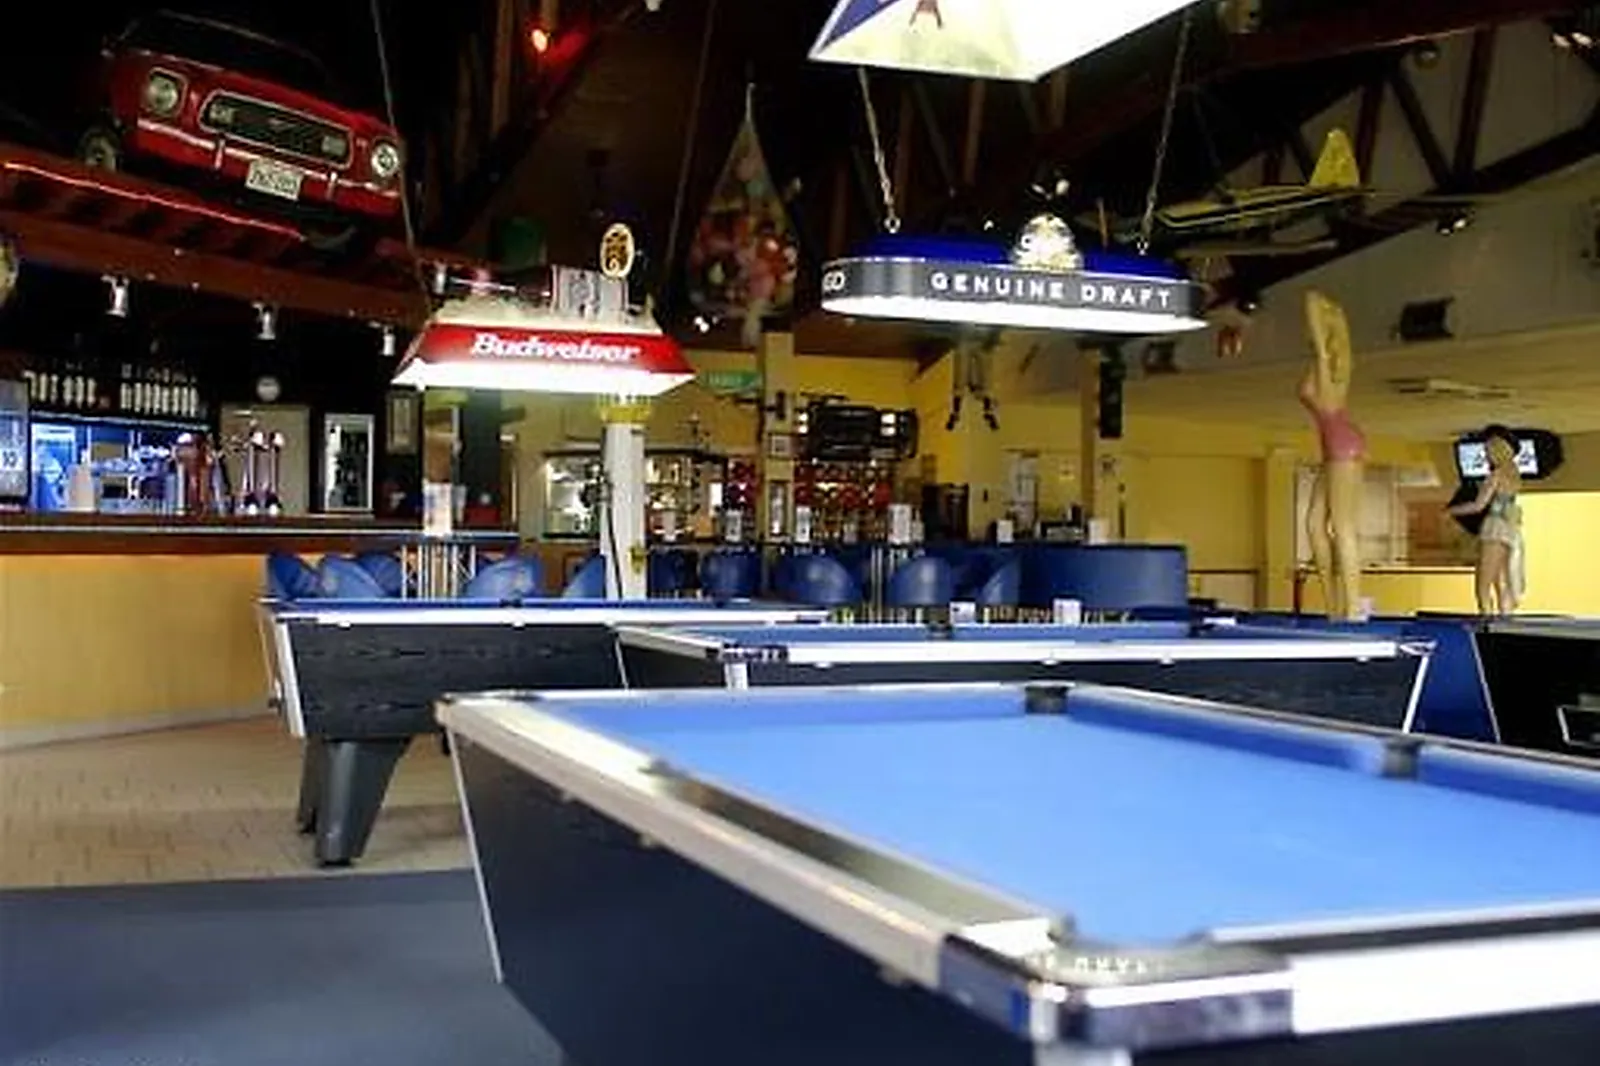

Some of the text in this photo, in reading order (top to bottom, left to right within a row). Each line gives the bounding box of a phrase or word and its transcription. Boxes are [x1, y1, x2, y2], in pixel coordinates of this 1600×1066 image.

[930, 271, 1171, 308] GENUINE DRAFT
[470, 331, 642, 362] Budweiser
